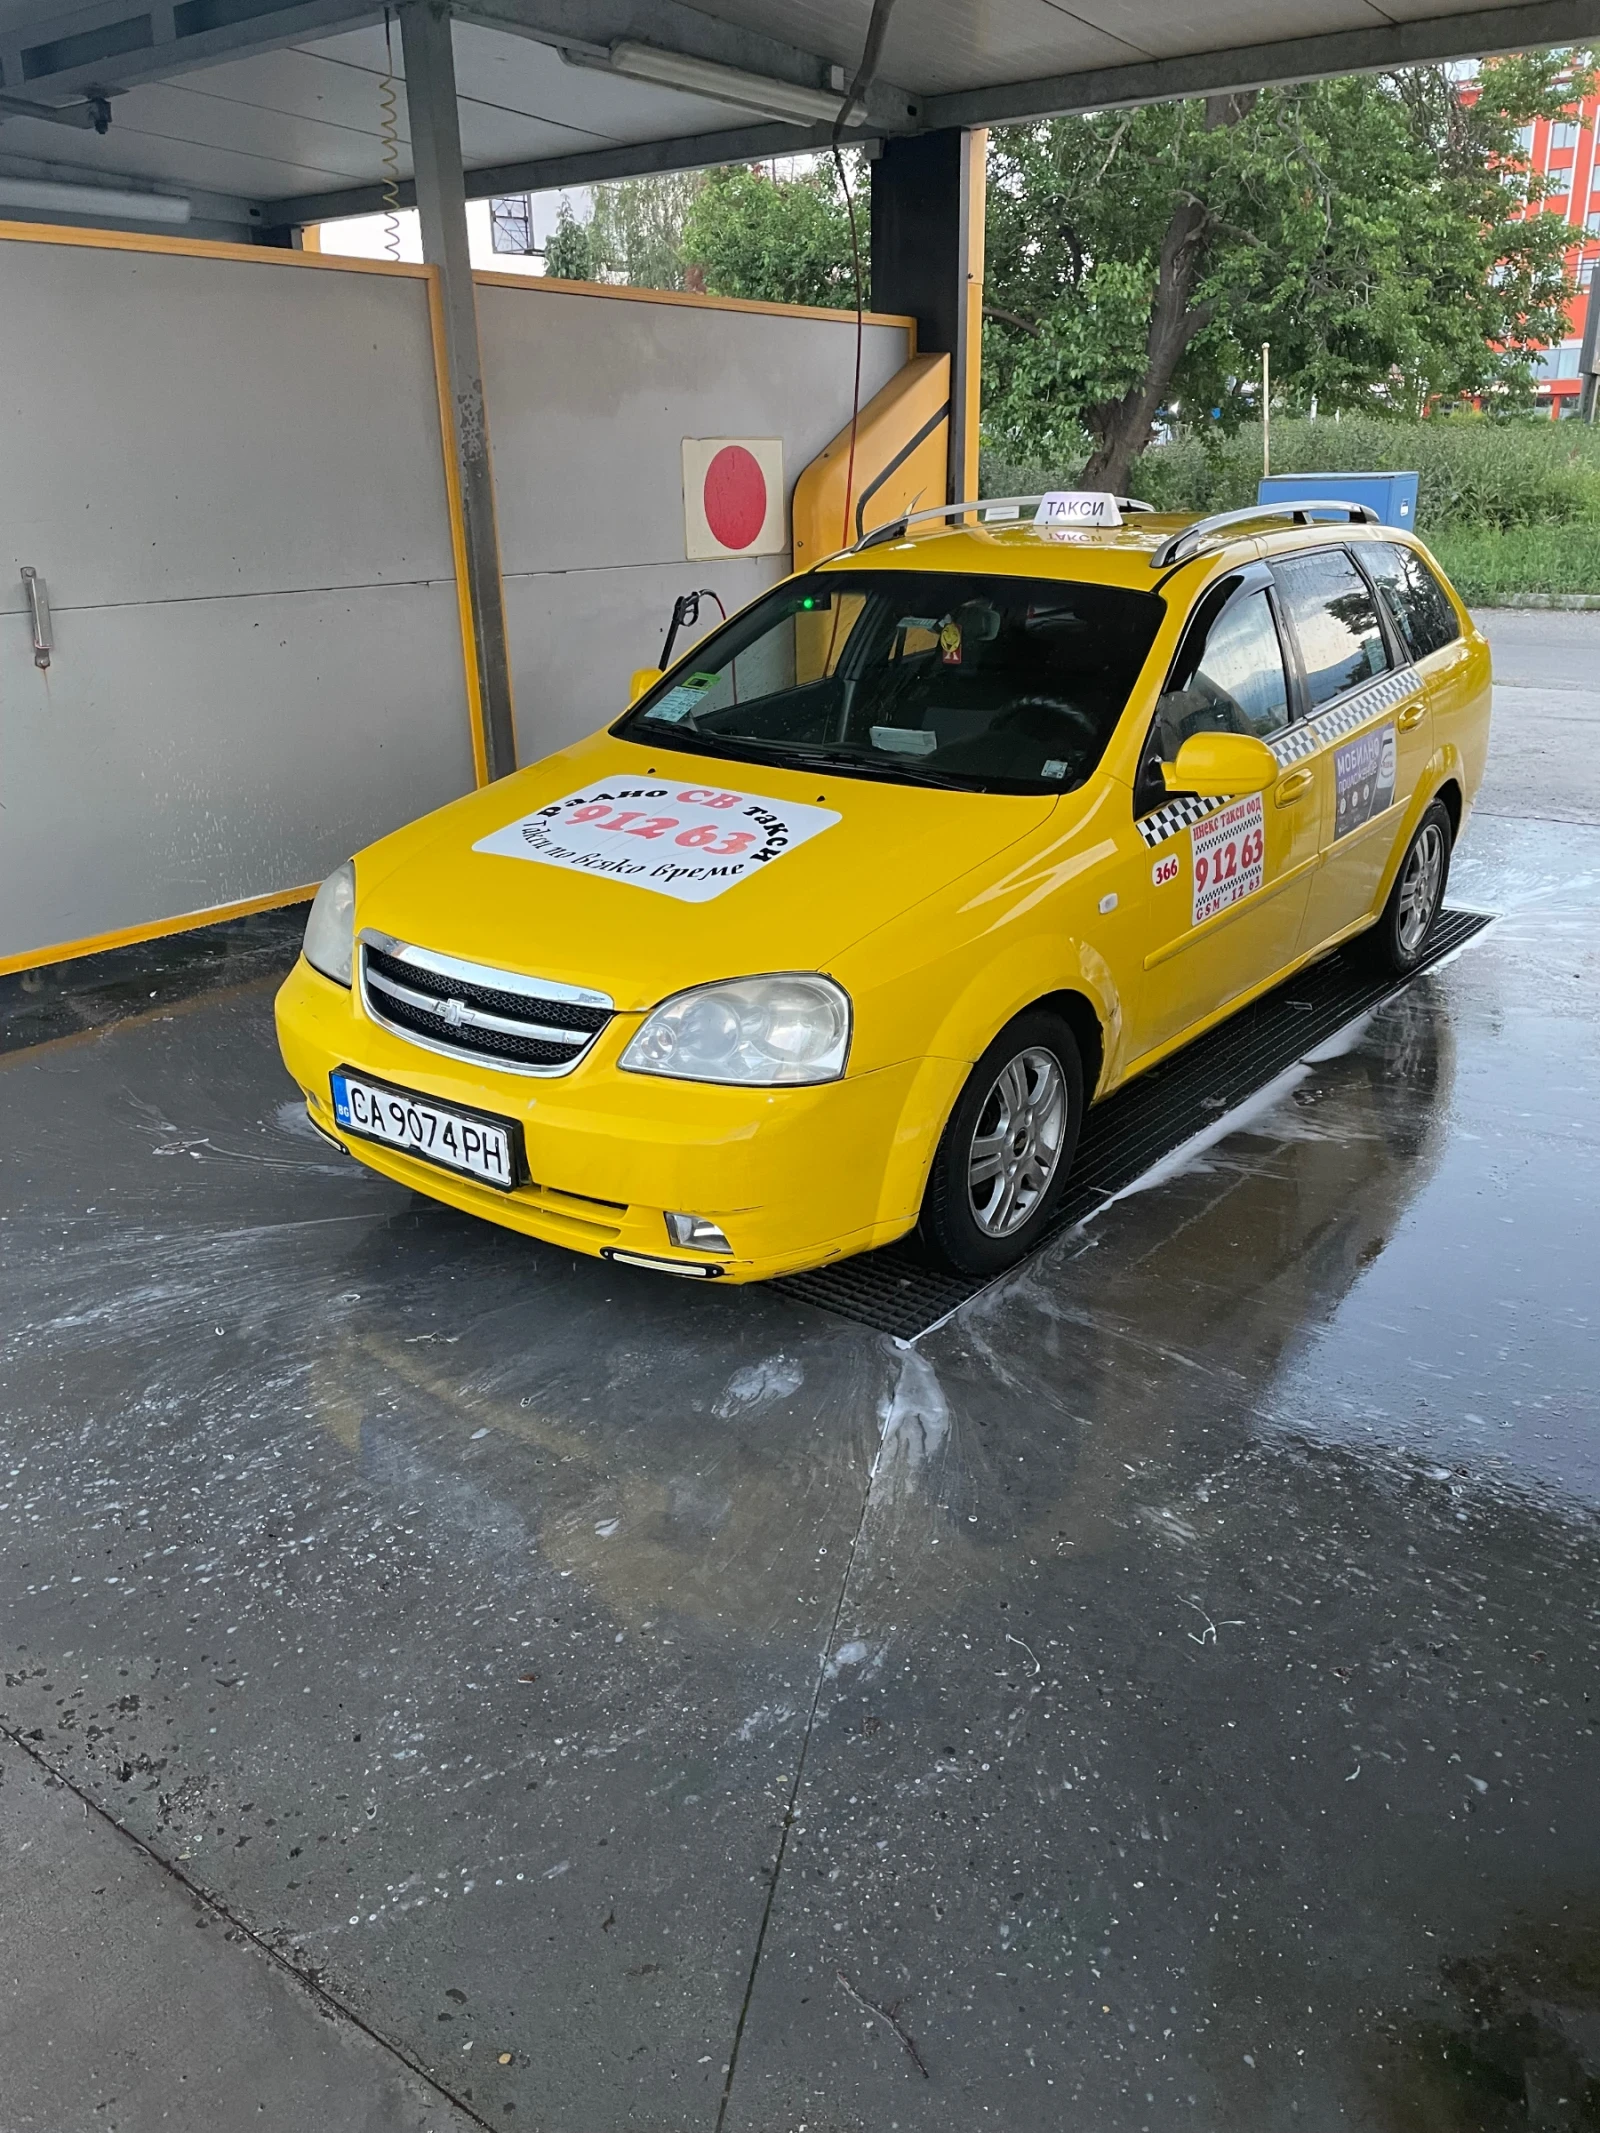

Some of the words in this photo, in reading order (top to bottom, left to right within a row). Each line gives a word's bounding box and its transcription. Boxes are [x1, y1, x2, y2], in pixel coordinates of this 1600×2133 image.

[1047, 501, 1104, 516] ТАКСИ
[742, 806, 788, 862] такси
[544, 846, 576, 859] по
[570, 853, 647, 874] всяко
[649, 863, 744, 882] време
[1156, 858, 1178, 885] 366
[1196, 898, 1221, 920] GSM
[337, 1104, 350, 1118] BG
